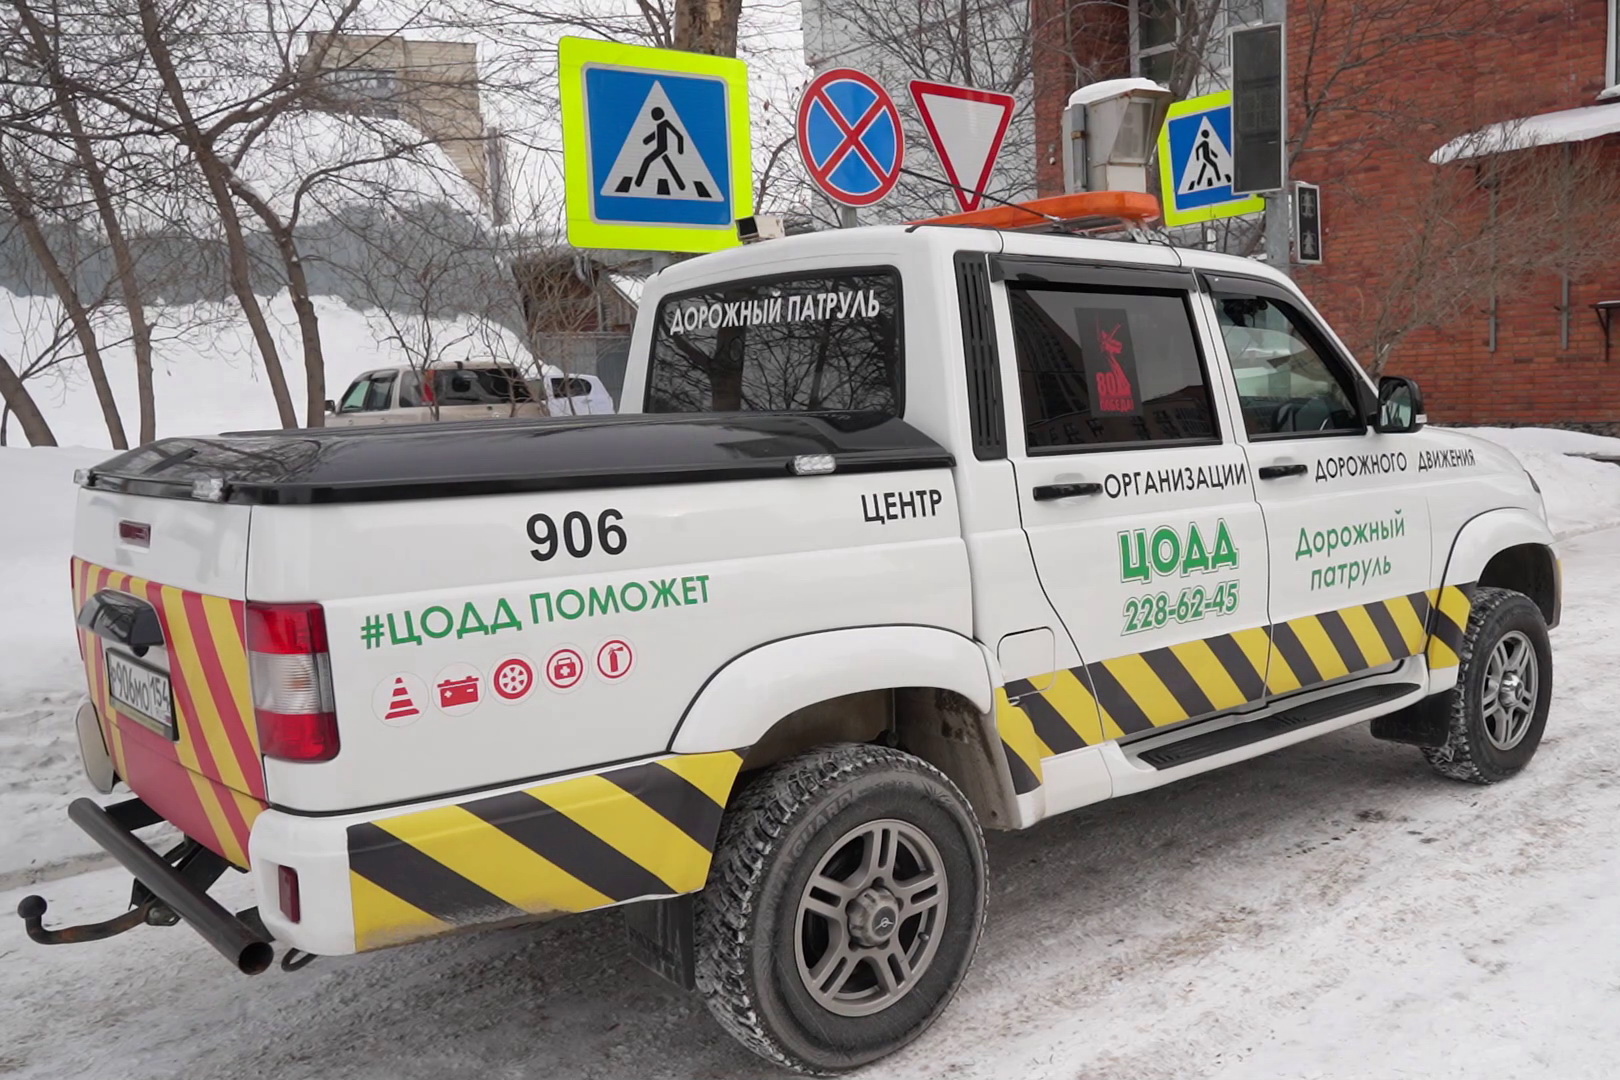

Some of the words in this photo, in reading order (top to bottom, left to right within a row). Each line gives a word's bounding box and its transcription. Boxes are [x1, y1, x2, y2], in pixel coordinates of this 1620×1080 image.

[669, 290, 781, 335] ДОРОЖНЫЙ
[787, 289, 880, 322] ПАТРУЛЬ
[861, 488, 943, 525] ЦЕНТР
[1104, 462, 1248, 500] ОРГАНИЗАЦИИ
[1315, 452, 1408, 483] ДОРОЖНОГО
[1418, 448, 1476, 473] ДВИЖЕНИЯ
[526, 508, 628, 562] 906
[1117, 517, 1240, 584] ЦОДД
[1295, 509, 1406, 560] Дорожный
[1310, 555, 1392, 591] патруль
[360, 597, 523, 650] #ЦОДД
[529, 575, 710, 625] ПОМОЖЕТ
[1120, 579, 1240, 636] 228-62-45
